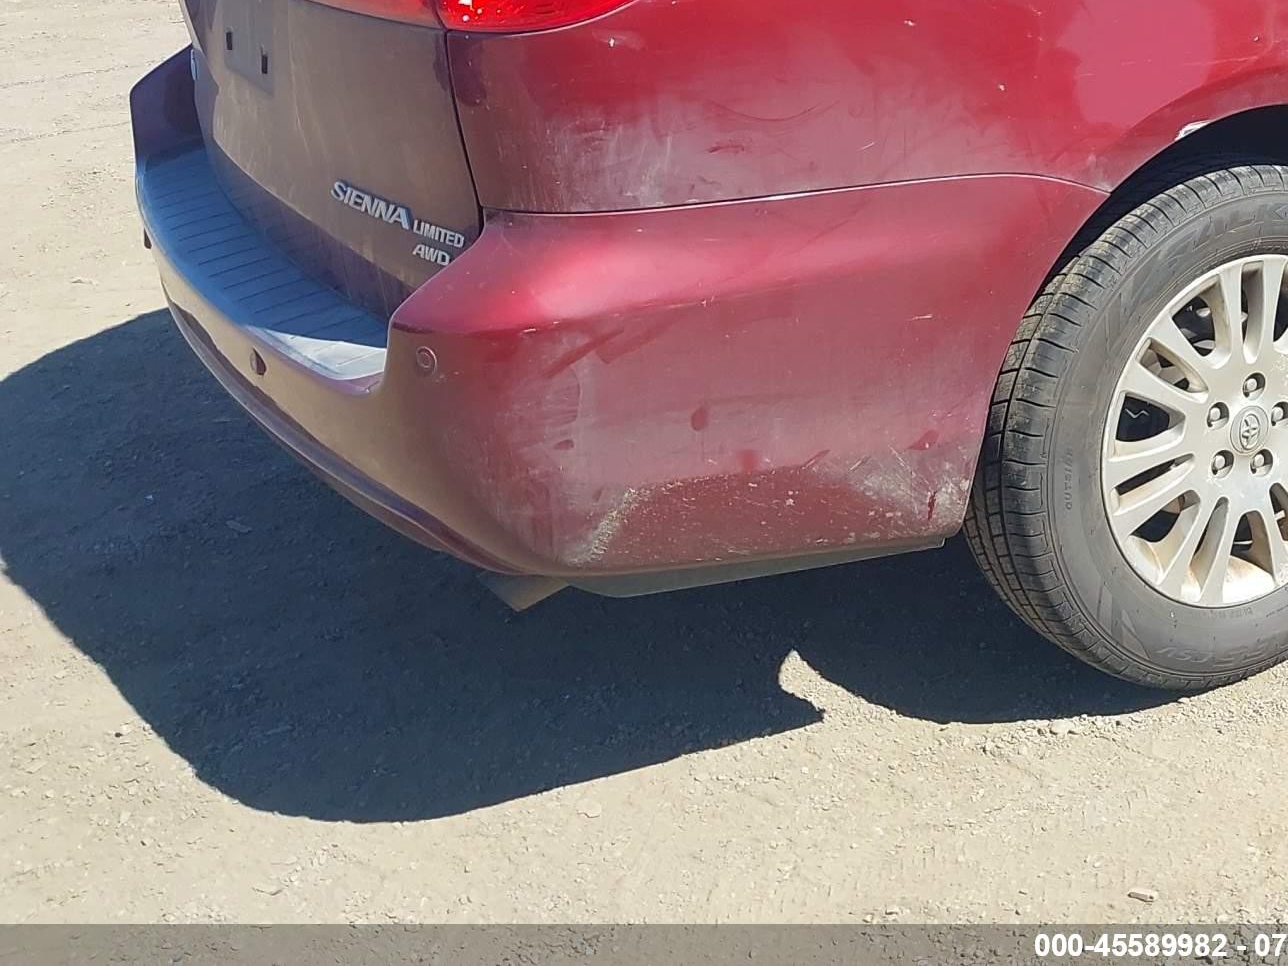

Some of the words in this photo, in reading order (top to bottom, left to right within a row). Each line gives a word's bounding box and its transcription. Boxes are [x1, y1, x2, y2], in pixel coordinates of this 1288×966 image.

[330, 180, 411, 230] SIENNA
[412, 219, 465, 248] LIMITED
[412, 243, 450, 266] AWD
